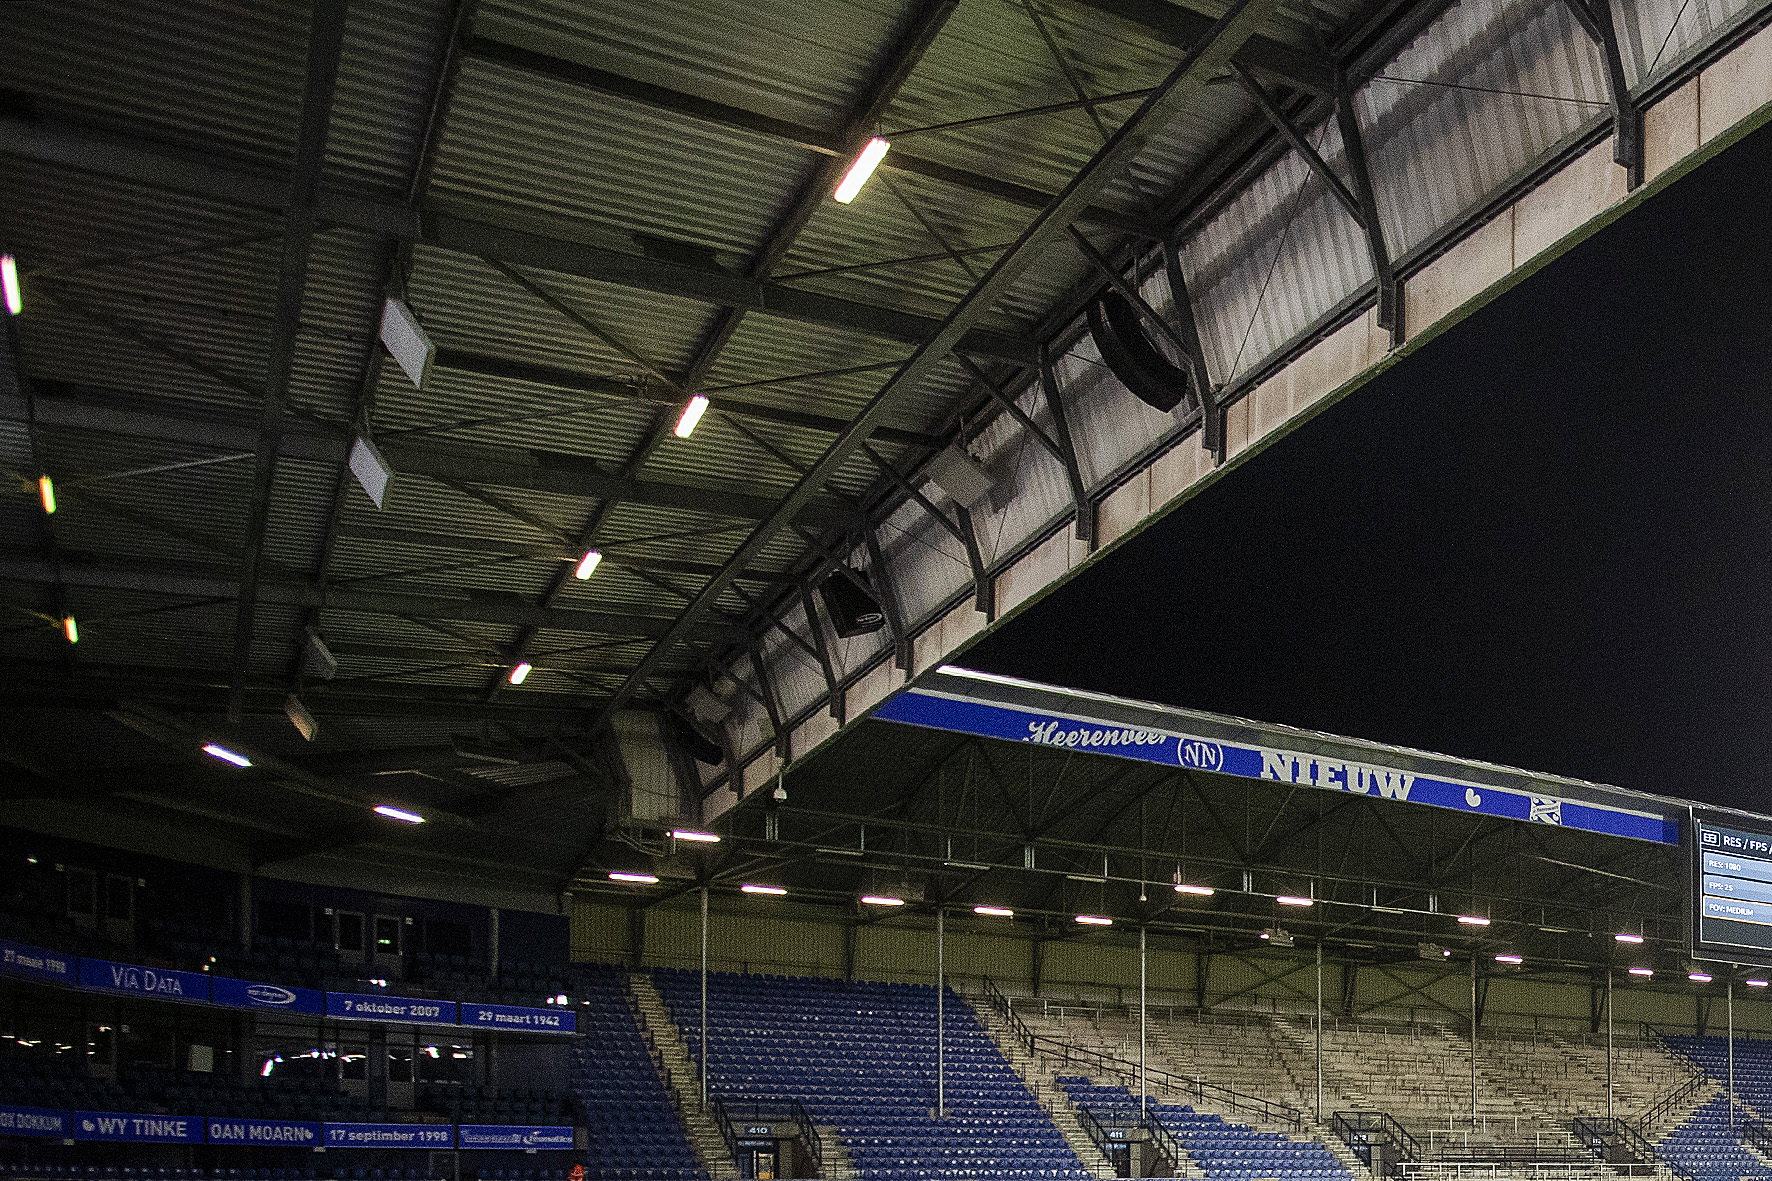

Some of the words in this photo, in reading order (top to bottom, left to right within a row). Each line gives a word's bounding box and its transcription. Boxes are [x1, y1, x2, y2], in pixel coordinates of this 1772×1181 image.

[1260, 750, 1416, 800] NIEUW
[1723, 836, 1742, 848] RES
[1750, 841, 1768, 852] FPS
[1708, 860, 1724, 869] RES:
[1725, 862, 1741, 871] 1080
[1709, 882, 1724, 891] FPS:
[1725, 883, 1734, 892] 25
[1709, 903, 1725, 913] FOV:
[1726, 906, 1754, 916] MEDIUM
[355, 1002, 406, 1016] oktober
[410, 1005, 440, 1018] 2007
[478, 1010, 493, 1022] 29
[495, 1013, 531, 1024] maart
[534, 1014, 560, 1026] 1942
[97, 1117, 128, 1135] WY
[132, 1119, 187, 1138] TINKE
[1109, 1131, 1123, 1139] 411
[330, 1129, 345, 1141] 17
[348, 1131, 415, 1143] septimber
[418, 1131, 449, 1142] 1998
